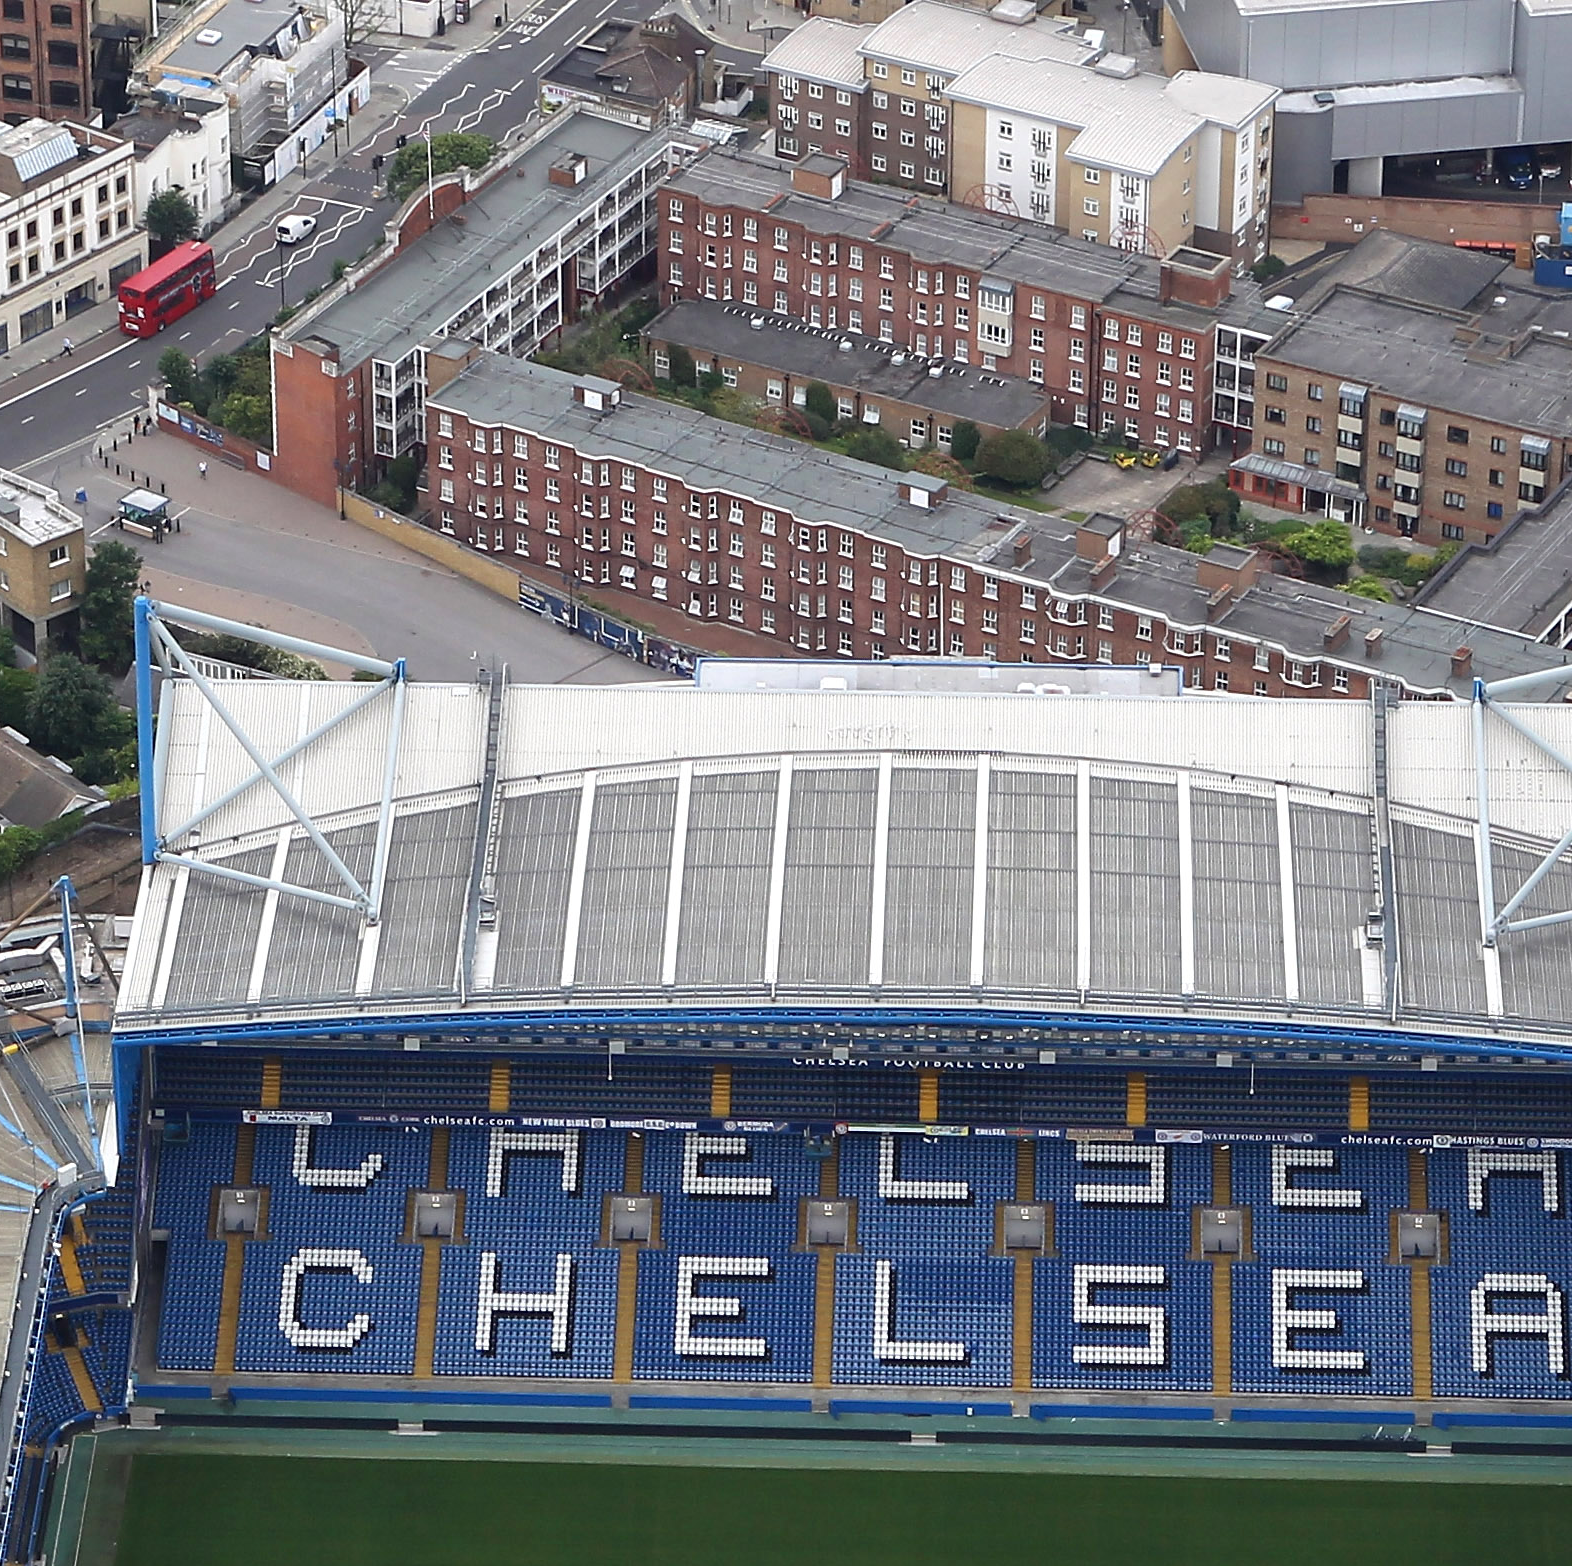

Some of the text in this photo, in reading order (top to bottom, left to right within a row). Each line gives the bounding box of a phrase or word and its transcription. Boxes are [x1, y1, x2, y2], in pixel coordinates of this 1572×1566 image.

[424, 1115, 515, 1126] chelseafc.com
[523, 1118, 541, 1126] NEW
[542, 1118, 565, 1127] YORK
[1203, 1133, 1263, 1142] WATERFORD
[1341, 1134, 1432, 1146] chelseafc.com
[1450, 1136, 1524, 1146] HASTINGS BLUES
[278, 1248, 1568, 1378] CHELSEA
